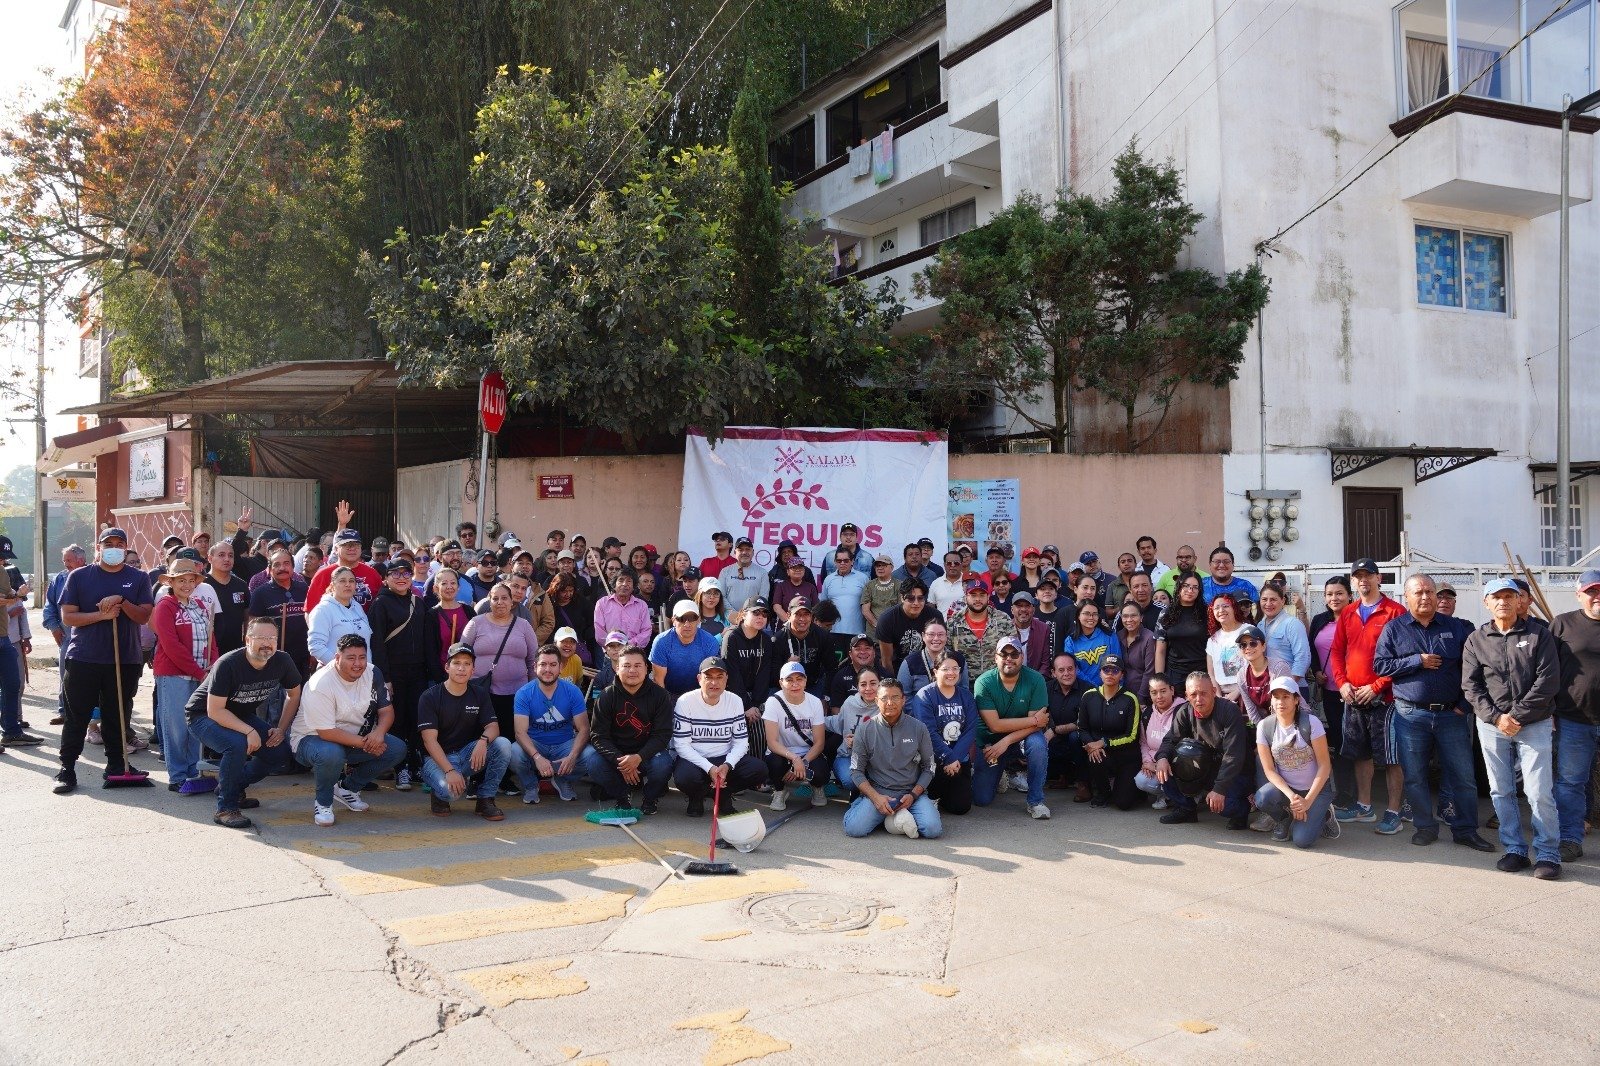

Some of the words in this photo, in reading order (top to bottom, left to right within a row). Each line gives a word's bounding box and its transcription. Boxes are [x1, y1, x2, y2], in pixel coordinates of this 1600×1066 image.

[483, 384, 504, 415] ALTO
[806, 455, 855, 464] XALAPA
[531, 720, 569, 732] adidas
[691, 727, 713, 737] LVIN
